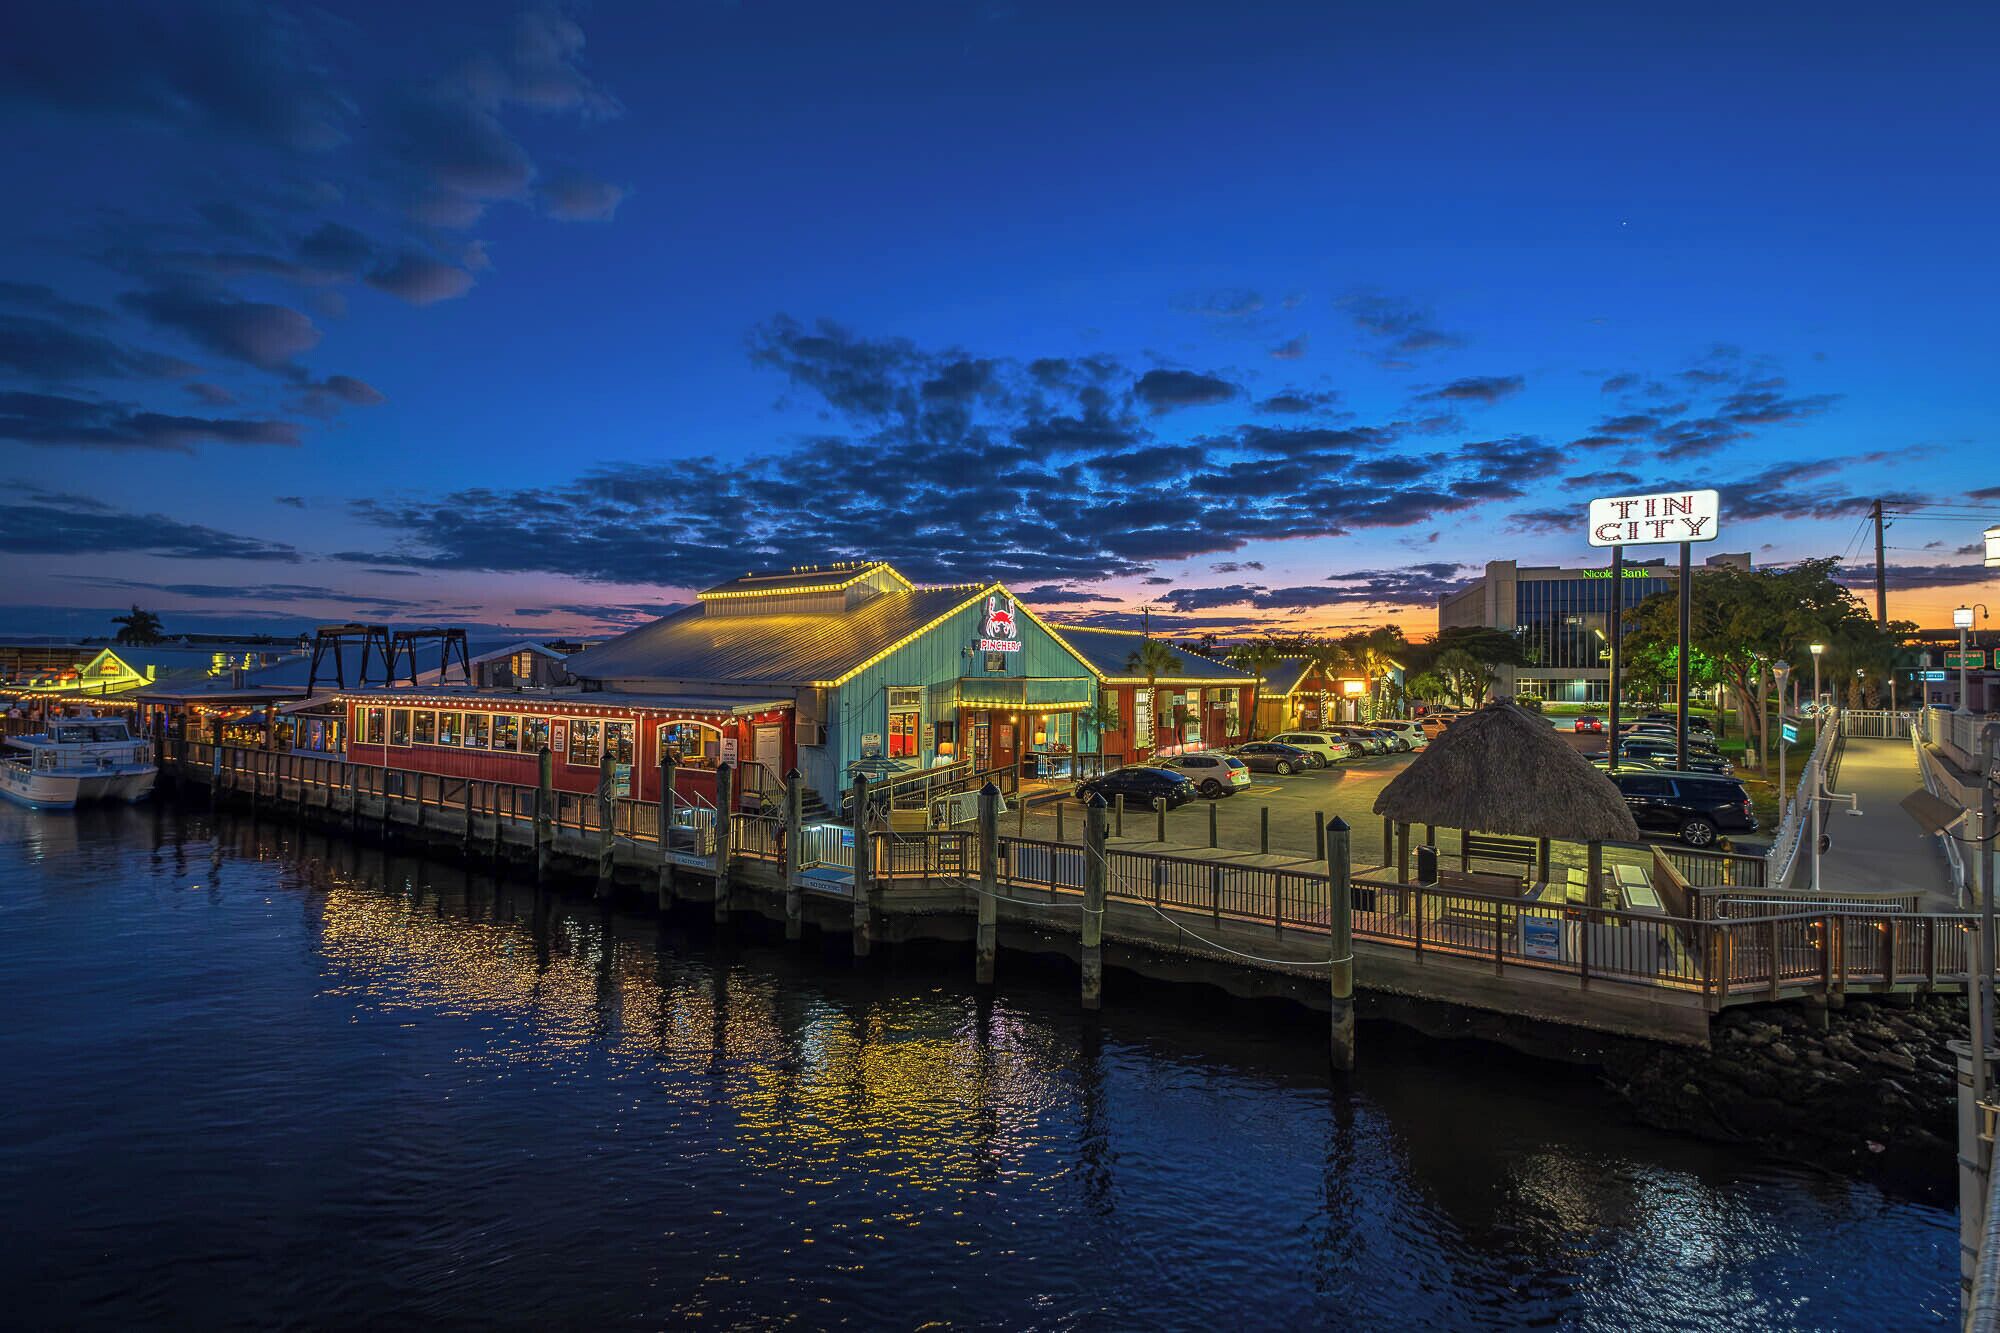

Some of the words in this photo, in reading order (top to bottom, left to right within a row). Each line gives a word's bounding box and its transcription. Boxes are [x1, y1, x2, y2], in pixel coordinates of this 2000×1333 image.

[1610, 496, 1694, 519] TIN
[1595, 516, 1711, 541] CITY
[1583, 569, 1614, 578] Nicole
[1621, 568, 1649, 578] Bank
[980, 639, 1022, 652] PINCHERS
